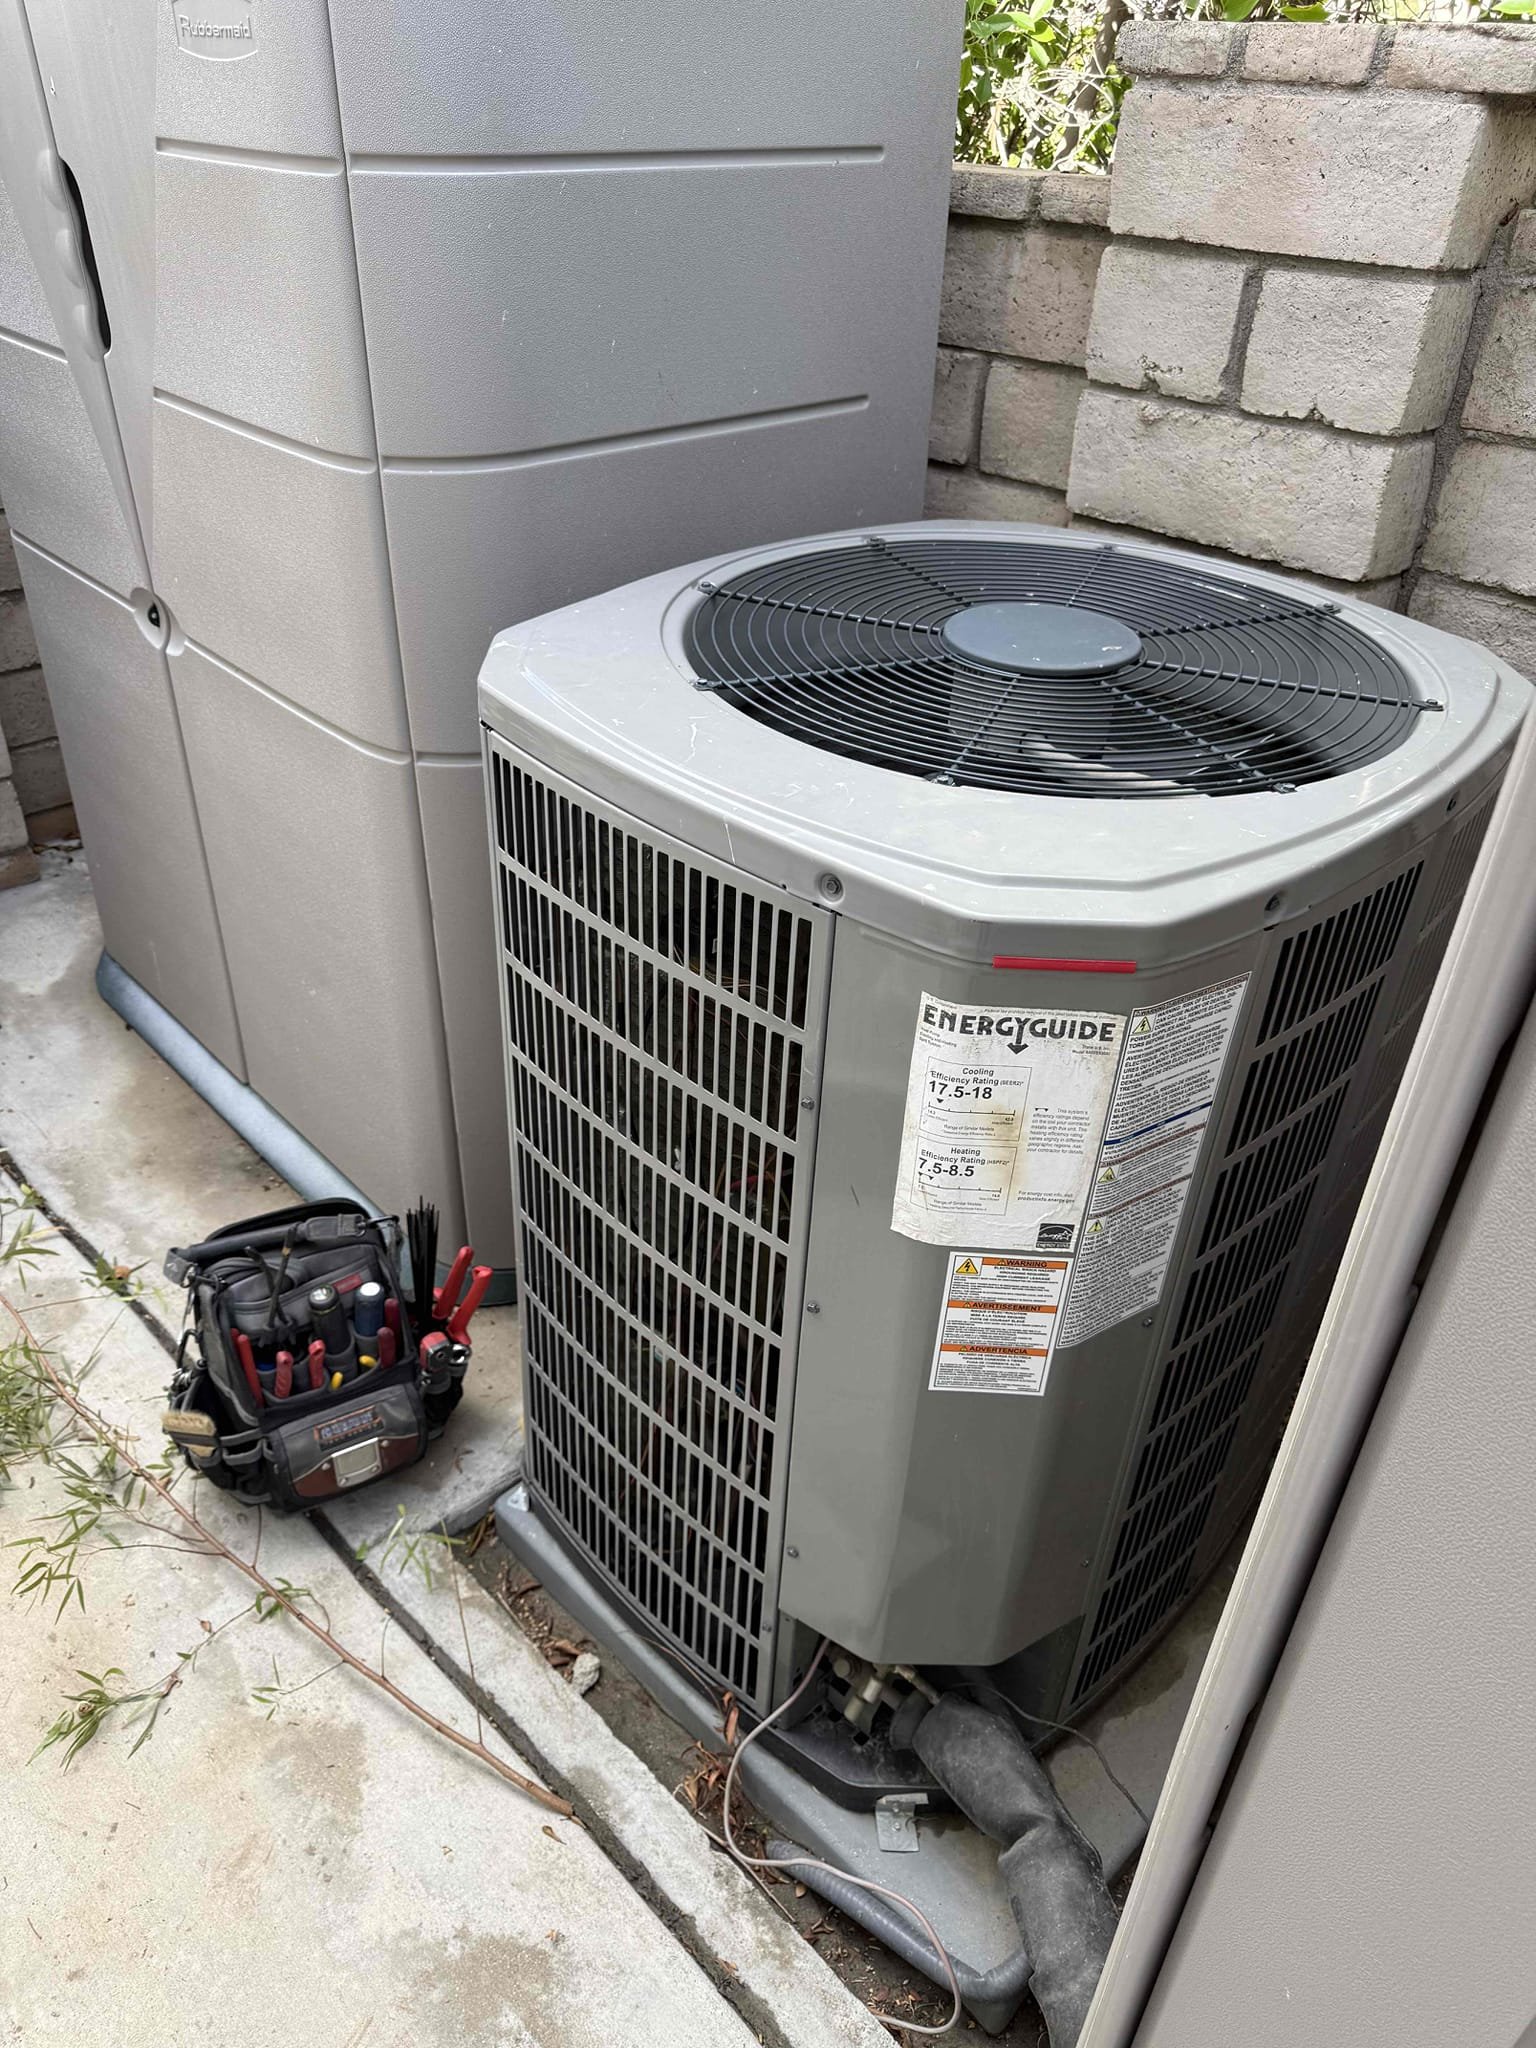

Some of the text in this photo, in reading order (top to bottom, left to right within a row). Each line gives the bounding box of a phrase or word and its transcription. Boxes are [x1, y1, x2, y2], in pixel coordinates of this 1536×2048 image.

[179, 15, 252, 38] Rubbermaid
[923, 1004, 1116, 1044] ENERGYGUIDE
[931, 1071, 970, 1085] Efficiency
[972, 1077, 998, 1086] Rating
[962, 1068, 994, 1077] Cooling
[929, 1080, 993, 1099] 17.5-18
[921, 1149, 958, 1164] Efficiency
[961, 1156, 986, 1165] Rating
[951, 1147, 981, 1156] Heating
[919, 1157, 974, 1177] 7.5-8.5
[973, 1303, 1041, 1311] AVERTISSEMENT
[970, 1345, 1028, 1354] ADVERTENCIA
